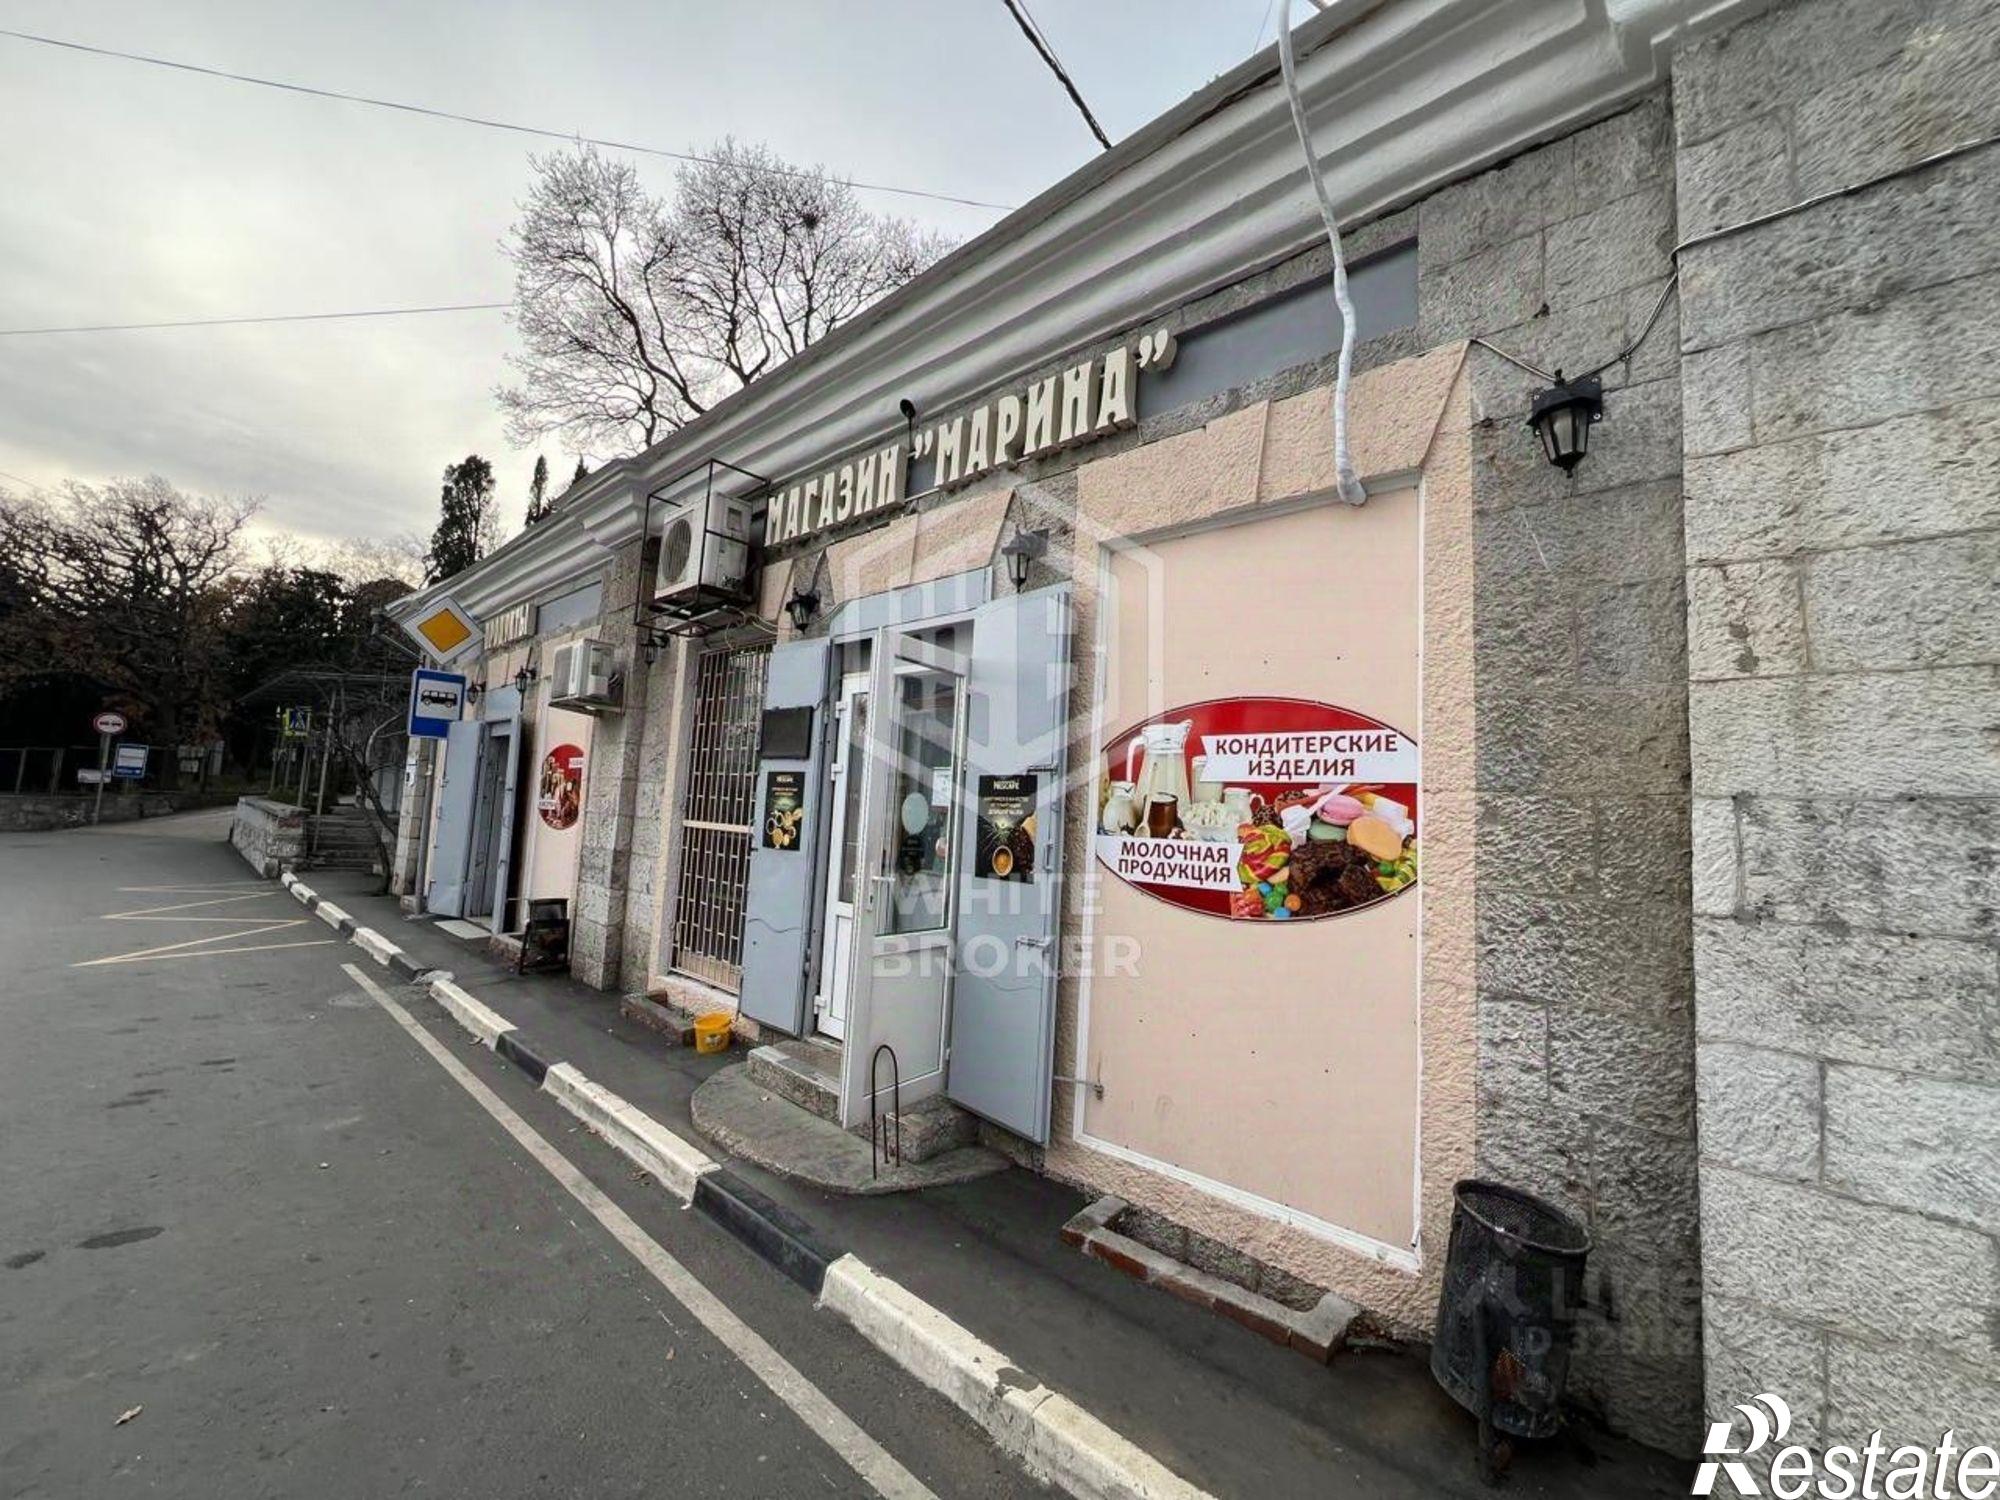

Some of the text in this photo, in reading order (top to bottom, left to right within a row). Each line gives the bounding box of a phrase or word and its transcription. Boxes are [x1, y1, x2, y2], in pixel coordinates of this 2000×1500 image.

[763, 443, 903, 548] МАГАЗИН
[1215, 733, 1399, 758] КОНДИТЕРСКИЕ
[1247, 758, 1355, 781] ИЗДЕЛИЯ
[1120, 840, 1229, 863] МОЛОЧНАЯ
[1117, 859, 1232, 884] ПРОДУКЦИЯ
